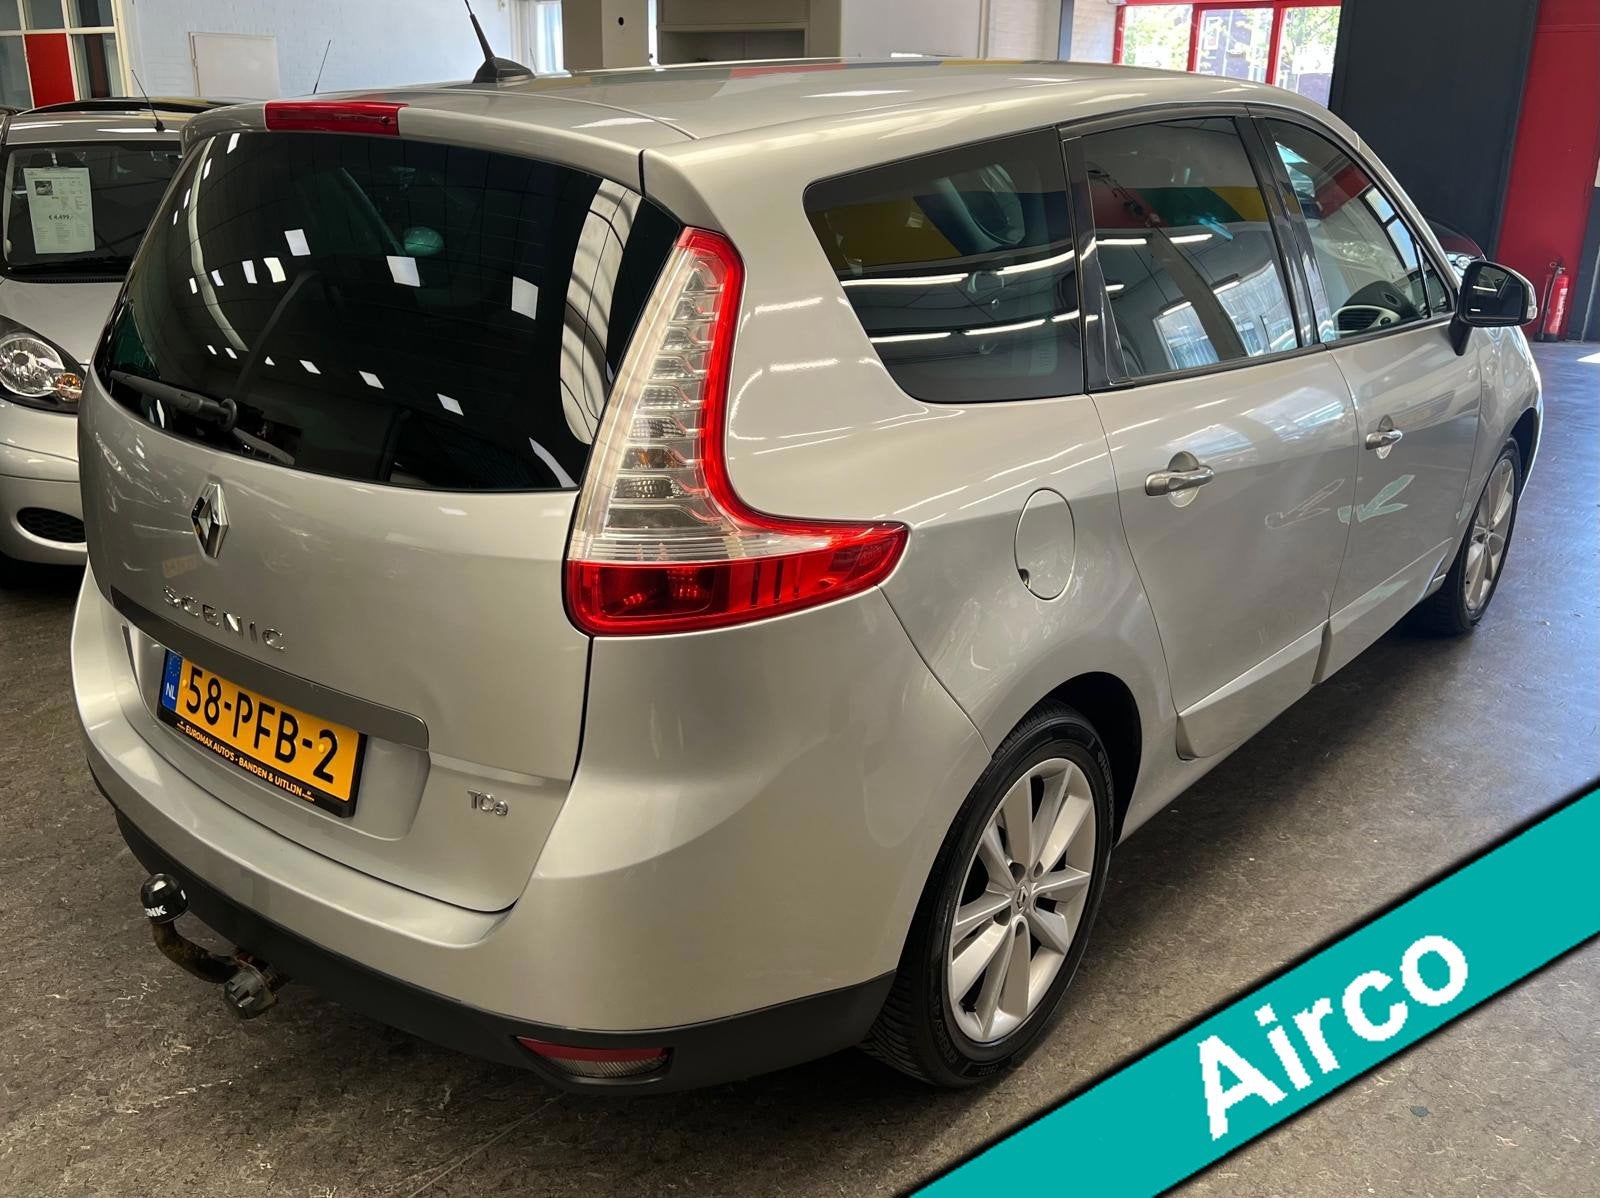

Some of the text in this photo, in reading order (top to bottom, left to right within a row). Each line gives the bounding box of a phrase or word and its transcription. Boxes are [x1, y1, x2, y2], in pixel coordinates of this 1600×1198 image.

[163, 585, 286, 651] SCENIC
[165, 682, 176, 700] NL
[186, 666, 338, 784] 58-PFB-2
[186, 725, 213, 748] EUROMAX
[213, 743, 235, 761] AUTO'S
[239, 757, 267, 779] BANDEN
[268, 773, 274, 782] &
[467, 789, 508, 816] TCe
